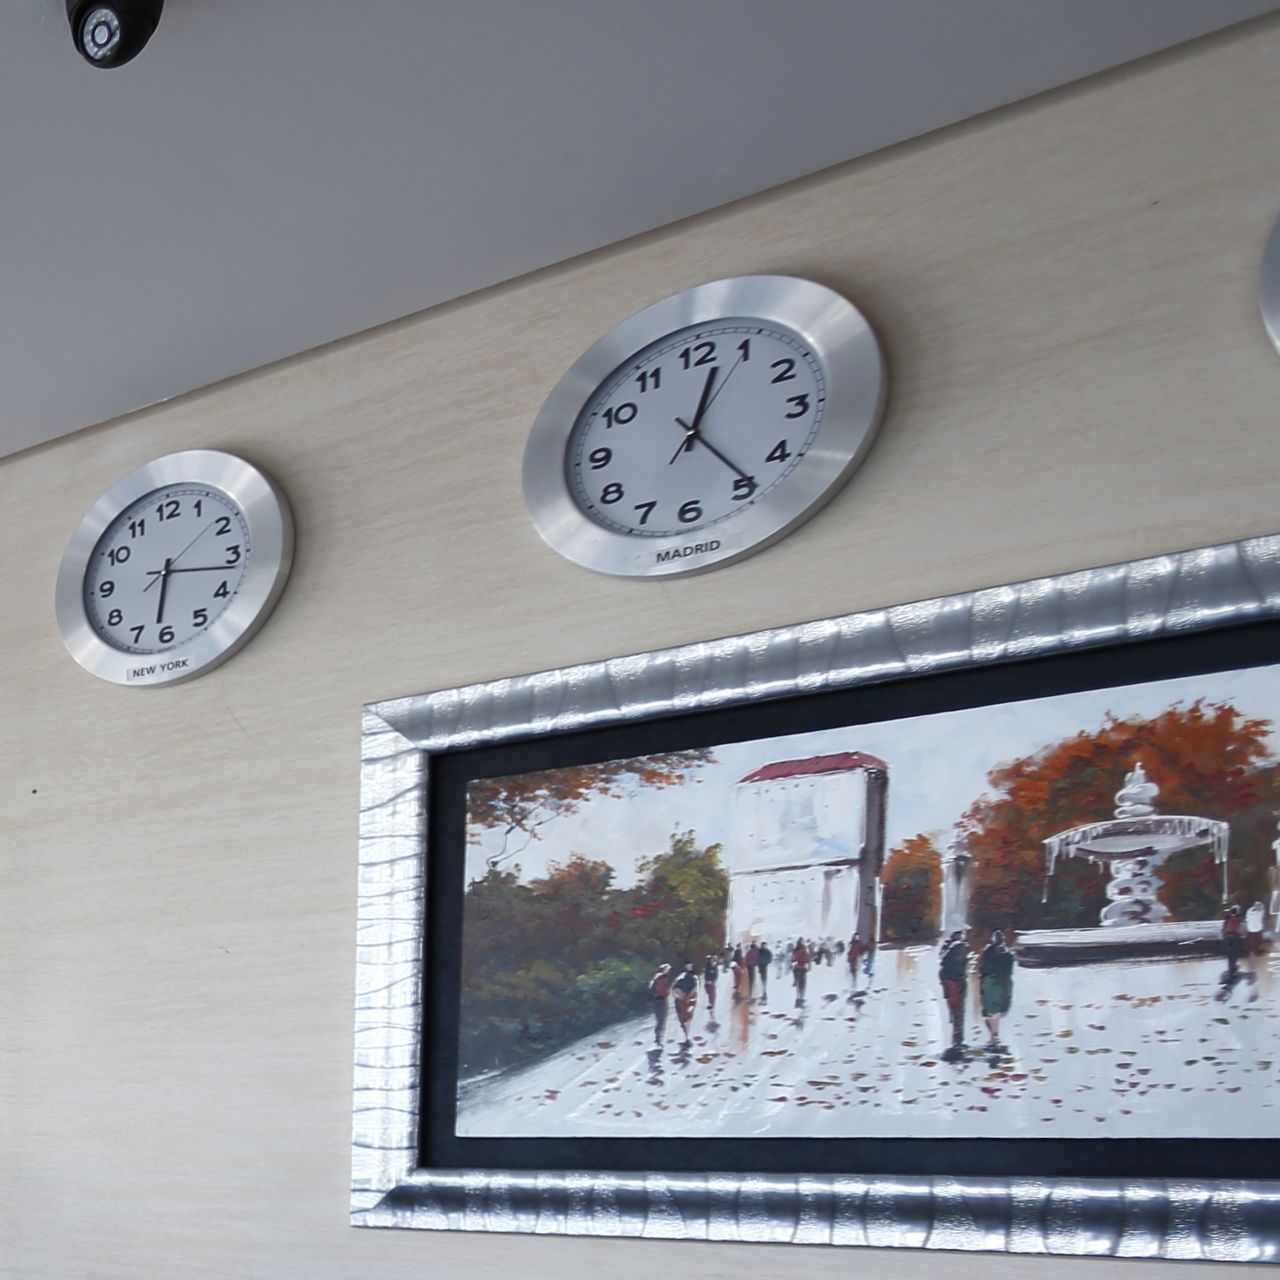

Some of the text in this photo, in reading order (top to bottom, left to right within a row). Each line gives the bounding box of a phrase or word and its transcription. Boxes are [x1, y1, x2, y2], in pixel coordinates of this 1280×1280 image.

[678, 342, 718, 370] 12
[737, 338, 751, 362] 1
[635, 366, 661, 393] 11
[770, 358, 797, 385] 2
[601, 402, 639, 429] 10
[785, 393, 810, 419] 3
[589, 447, 613, 470] 9
[764, 439, 792, 463] 4
[600, 482, 625, 505] 8
[732, 476, 758, 501] 5
[155, 500, 181, 521] 12
[192, 499, 202, 518] 1
[633, 501, 658, 526] 7
[677, 499, 703, 524] 6
[128, 518, 145, 539] 11
[214, 516, 232, 536] 2
[108, 545, 131, 567] 10
[225, 544, 241, 565] 3
[656, 540, 721, 563] MADRID
[99, 580, 115, 599] 9
[213, 580, 231, 599] 4
[107, 608, 124, 627] 8
[192, 608, 209, 628] 5
[129, 625, 145, 644] 7
[158, 625, 176, 644] 6
[133, 659, 189, 677] NEW YORK
